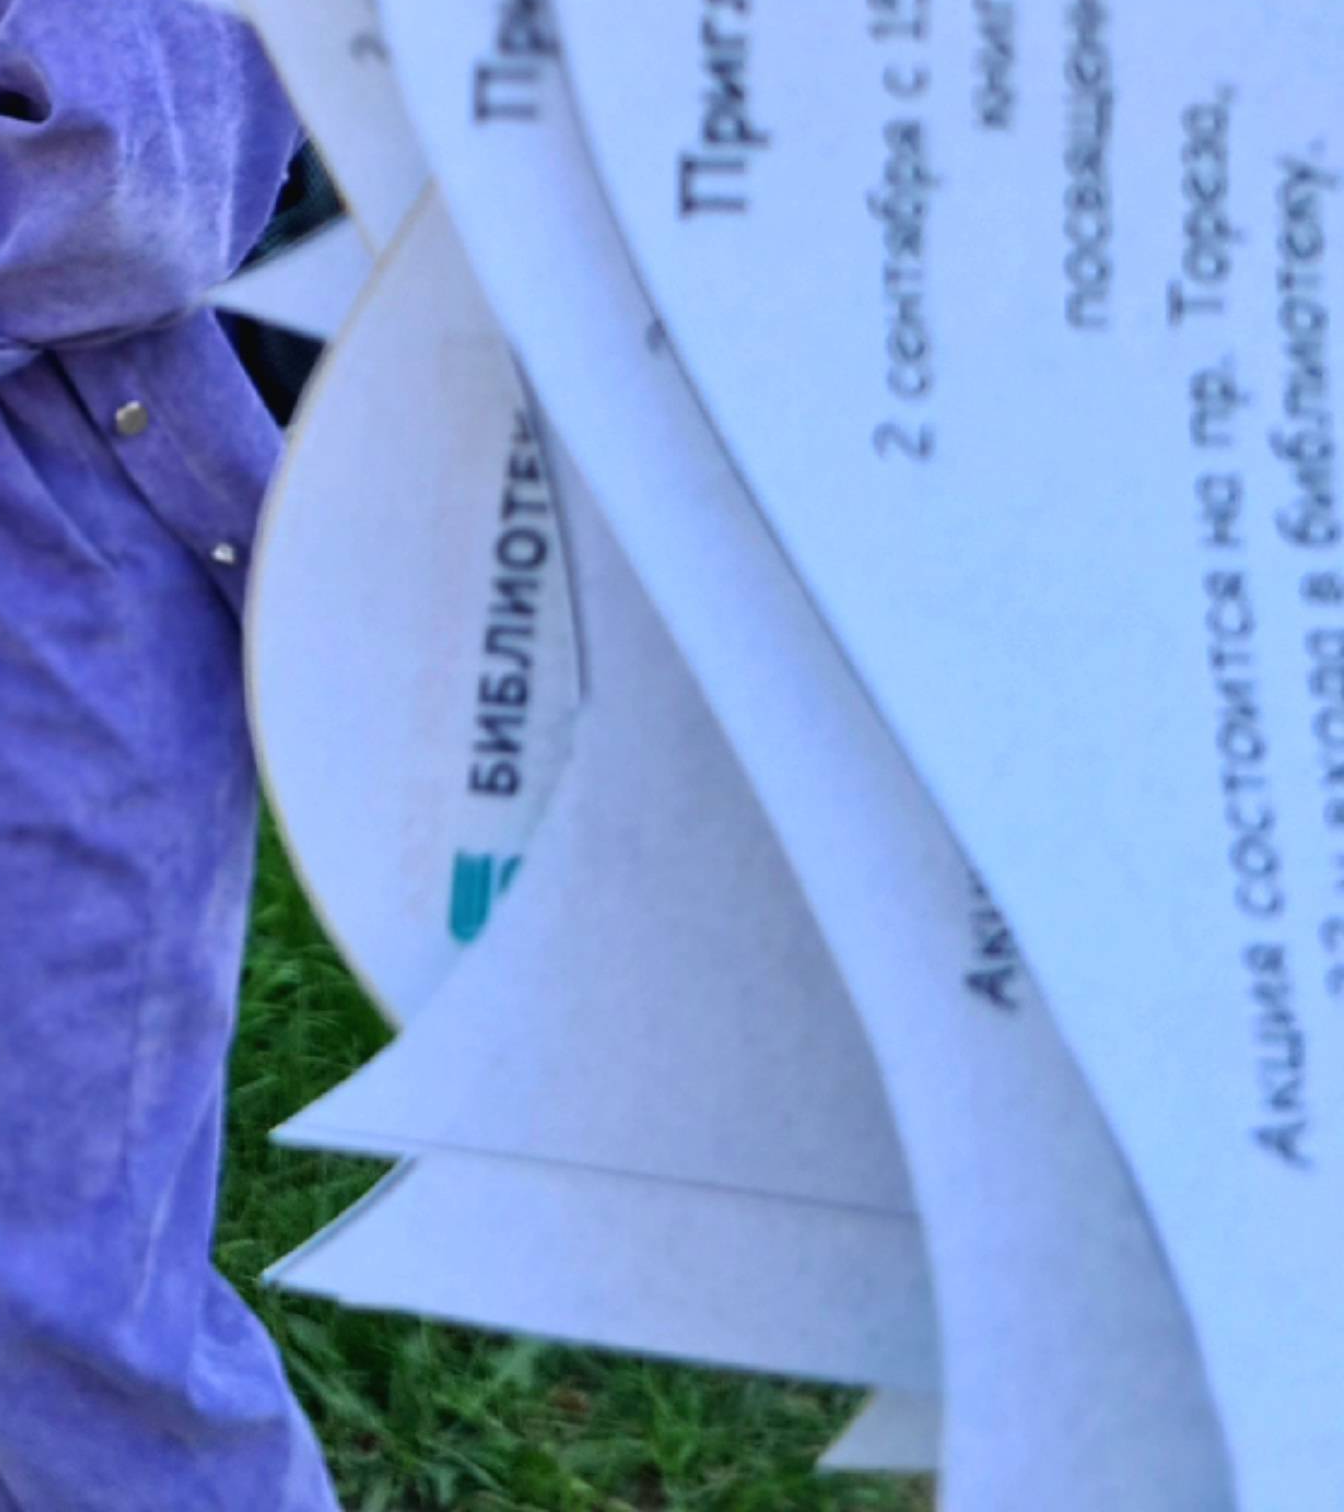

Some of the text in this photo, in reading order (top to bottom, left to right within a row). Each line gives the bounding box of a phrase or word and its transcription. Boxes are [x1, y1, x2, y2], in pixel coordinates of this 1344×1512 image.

[865, 119, 942, 399] сентября
[871, 420, 935, 463] 2
[1166, 84, 1312, 1170] Акция состоится на пр. Тореза,
